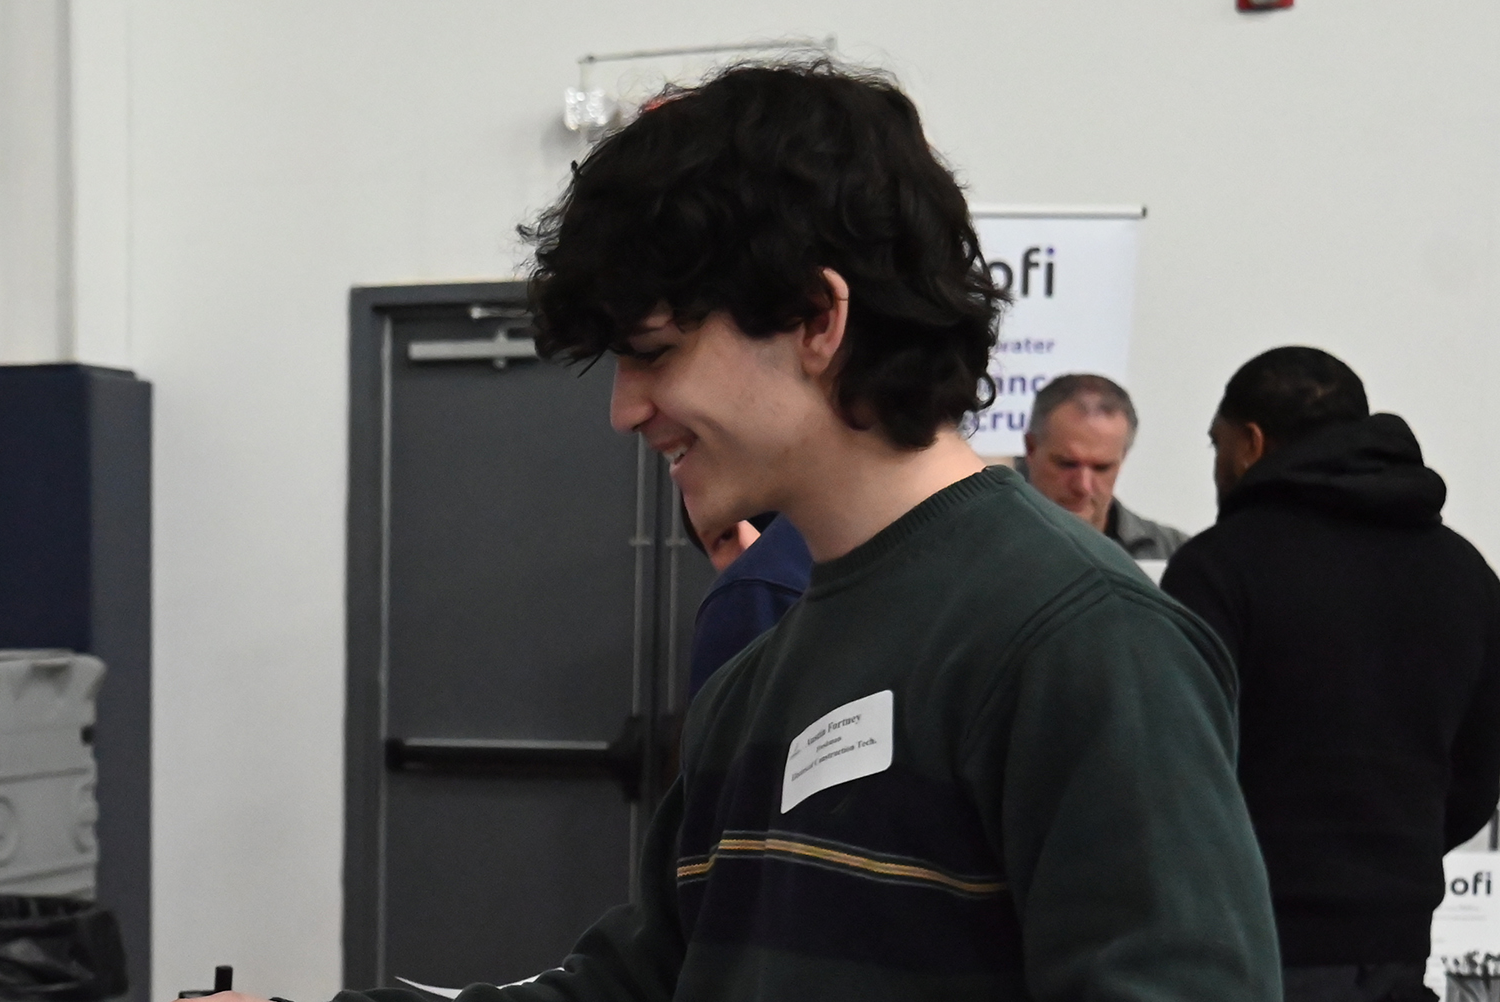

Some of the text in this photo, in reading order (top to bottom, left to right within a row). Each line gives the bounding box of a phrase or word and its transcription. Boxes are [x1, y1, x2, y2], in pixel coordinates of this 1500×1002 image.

[827, 713, 862, 734] Fortney
[857, 736, 878, 750] Tech.
[1451, 871, 1491, 896] ofi
